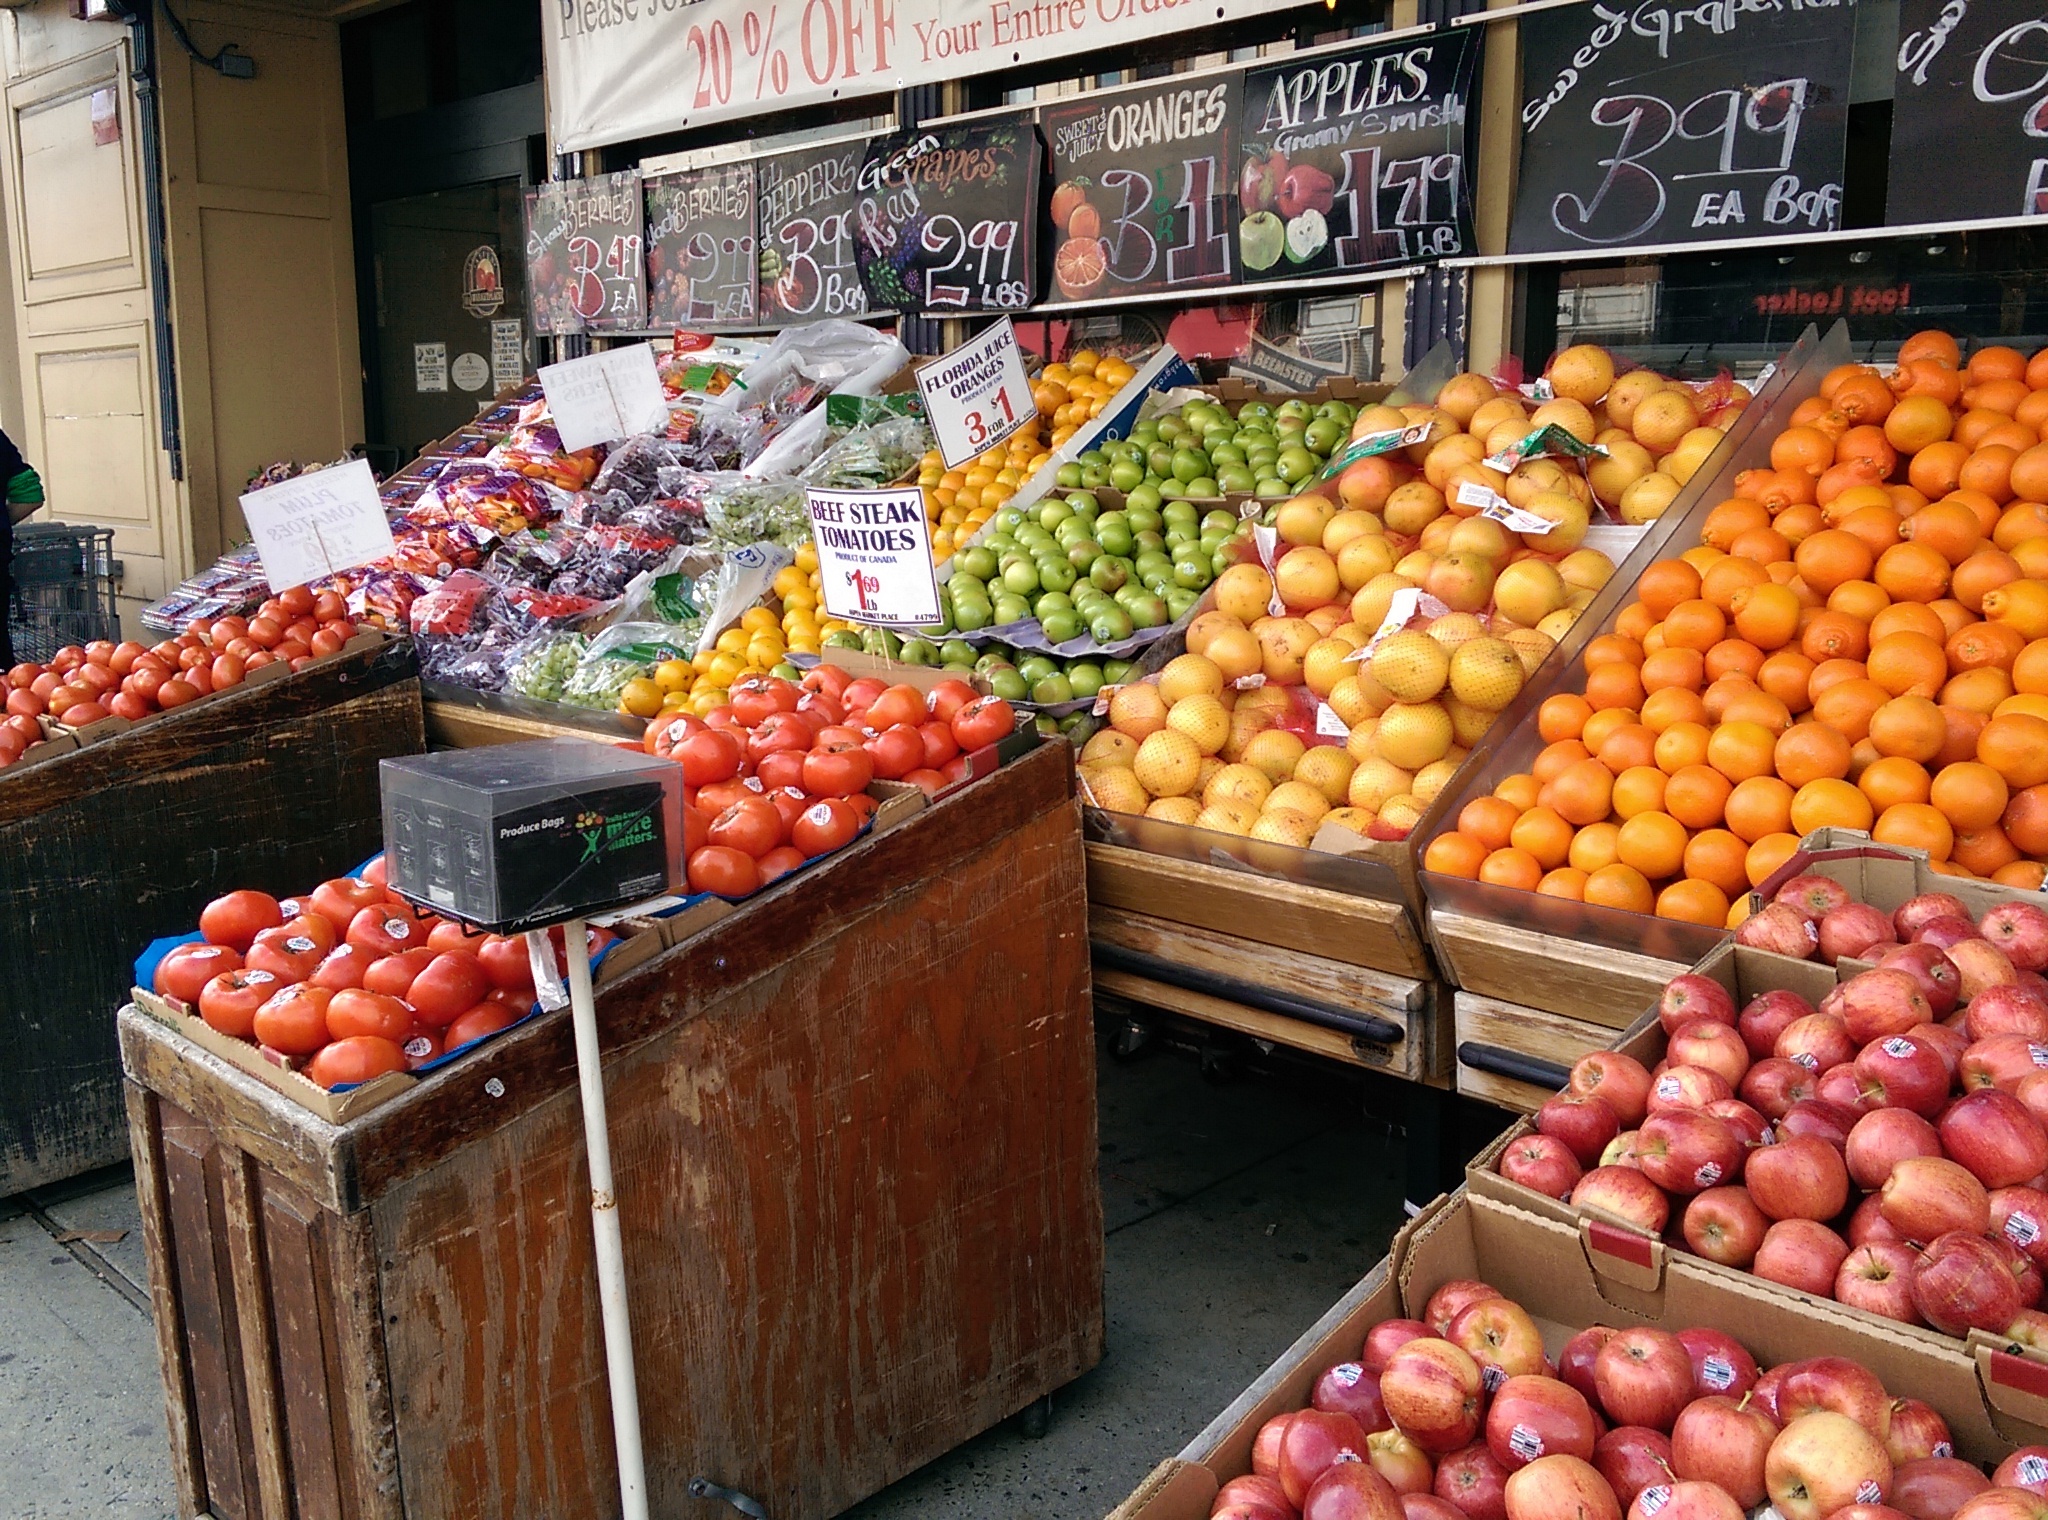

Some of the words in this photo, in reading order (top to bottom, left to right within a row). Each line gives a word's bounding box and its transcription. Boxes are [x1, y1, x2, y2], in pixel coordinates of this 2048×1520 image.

[913, 18, 982, 62] Your
[991, 0, 1086, 47] Entire
[686, 19, 733, 109] 20
[742, 4, 789, 100] %
[801, 0, 896, 85] OFF
[1055, 114, 1099, 156] SWEET
[1107, 83, 1227, 152] ORANGES
[1069, 132, 1106, 163] JUICY
[1273, 120, 1354, 160] Granny
[857, 134, 941, 193] Green
[674, 179, 749, 233] BERRIES
[760, 152, 857, 233] PEPPERS
[858, 168, 920, 258] Red
[1691, 190, 1746, 228] EA
[563, 188, 634, 240] BERRIES
[1166, 156, 1231, 284] 1
[610, 283, 638, 313] EA
[982, 280, 1028, 309] LBS
[925, 352, 983, 394] FLORIDA
[984, 330, 1013, 361] JUICE
[950, 356, 1005, 399] ORANGES
[1253, 350, 1316, 388] BEEMSTER
[964, 411, 987, 445] 3
[987, 417, 1005, 436] FOR
[811, 499, 845, 523] BEEF
[849, 500, 921, 525] STEAK
[819, 525, 916, 552] TOMATOES
[835, 552, 858, 562] PRODUCT
[859, 555, 867, 563] OF
[869, 555, 897, 564] CANADA
[500, 820, 540, 840] Produce
[541, 815, 565, 829] Bags
